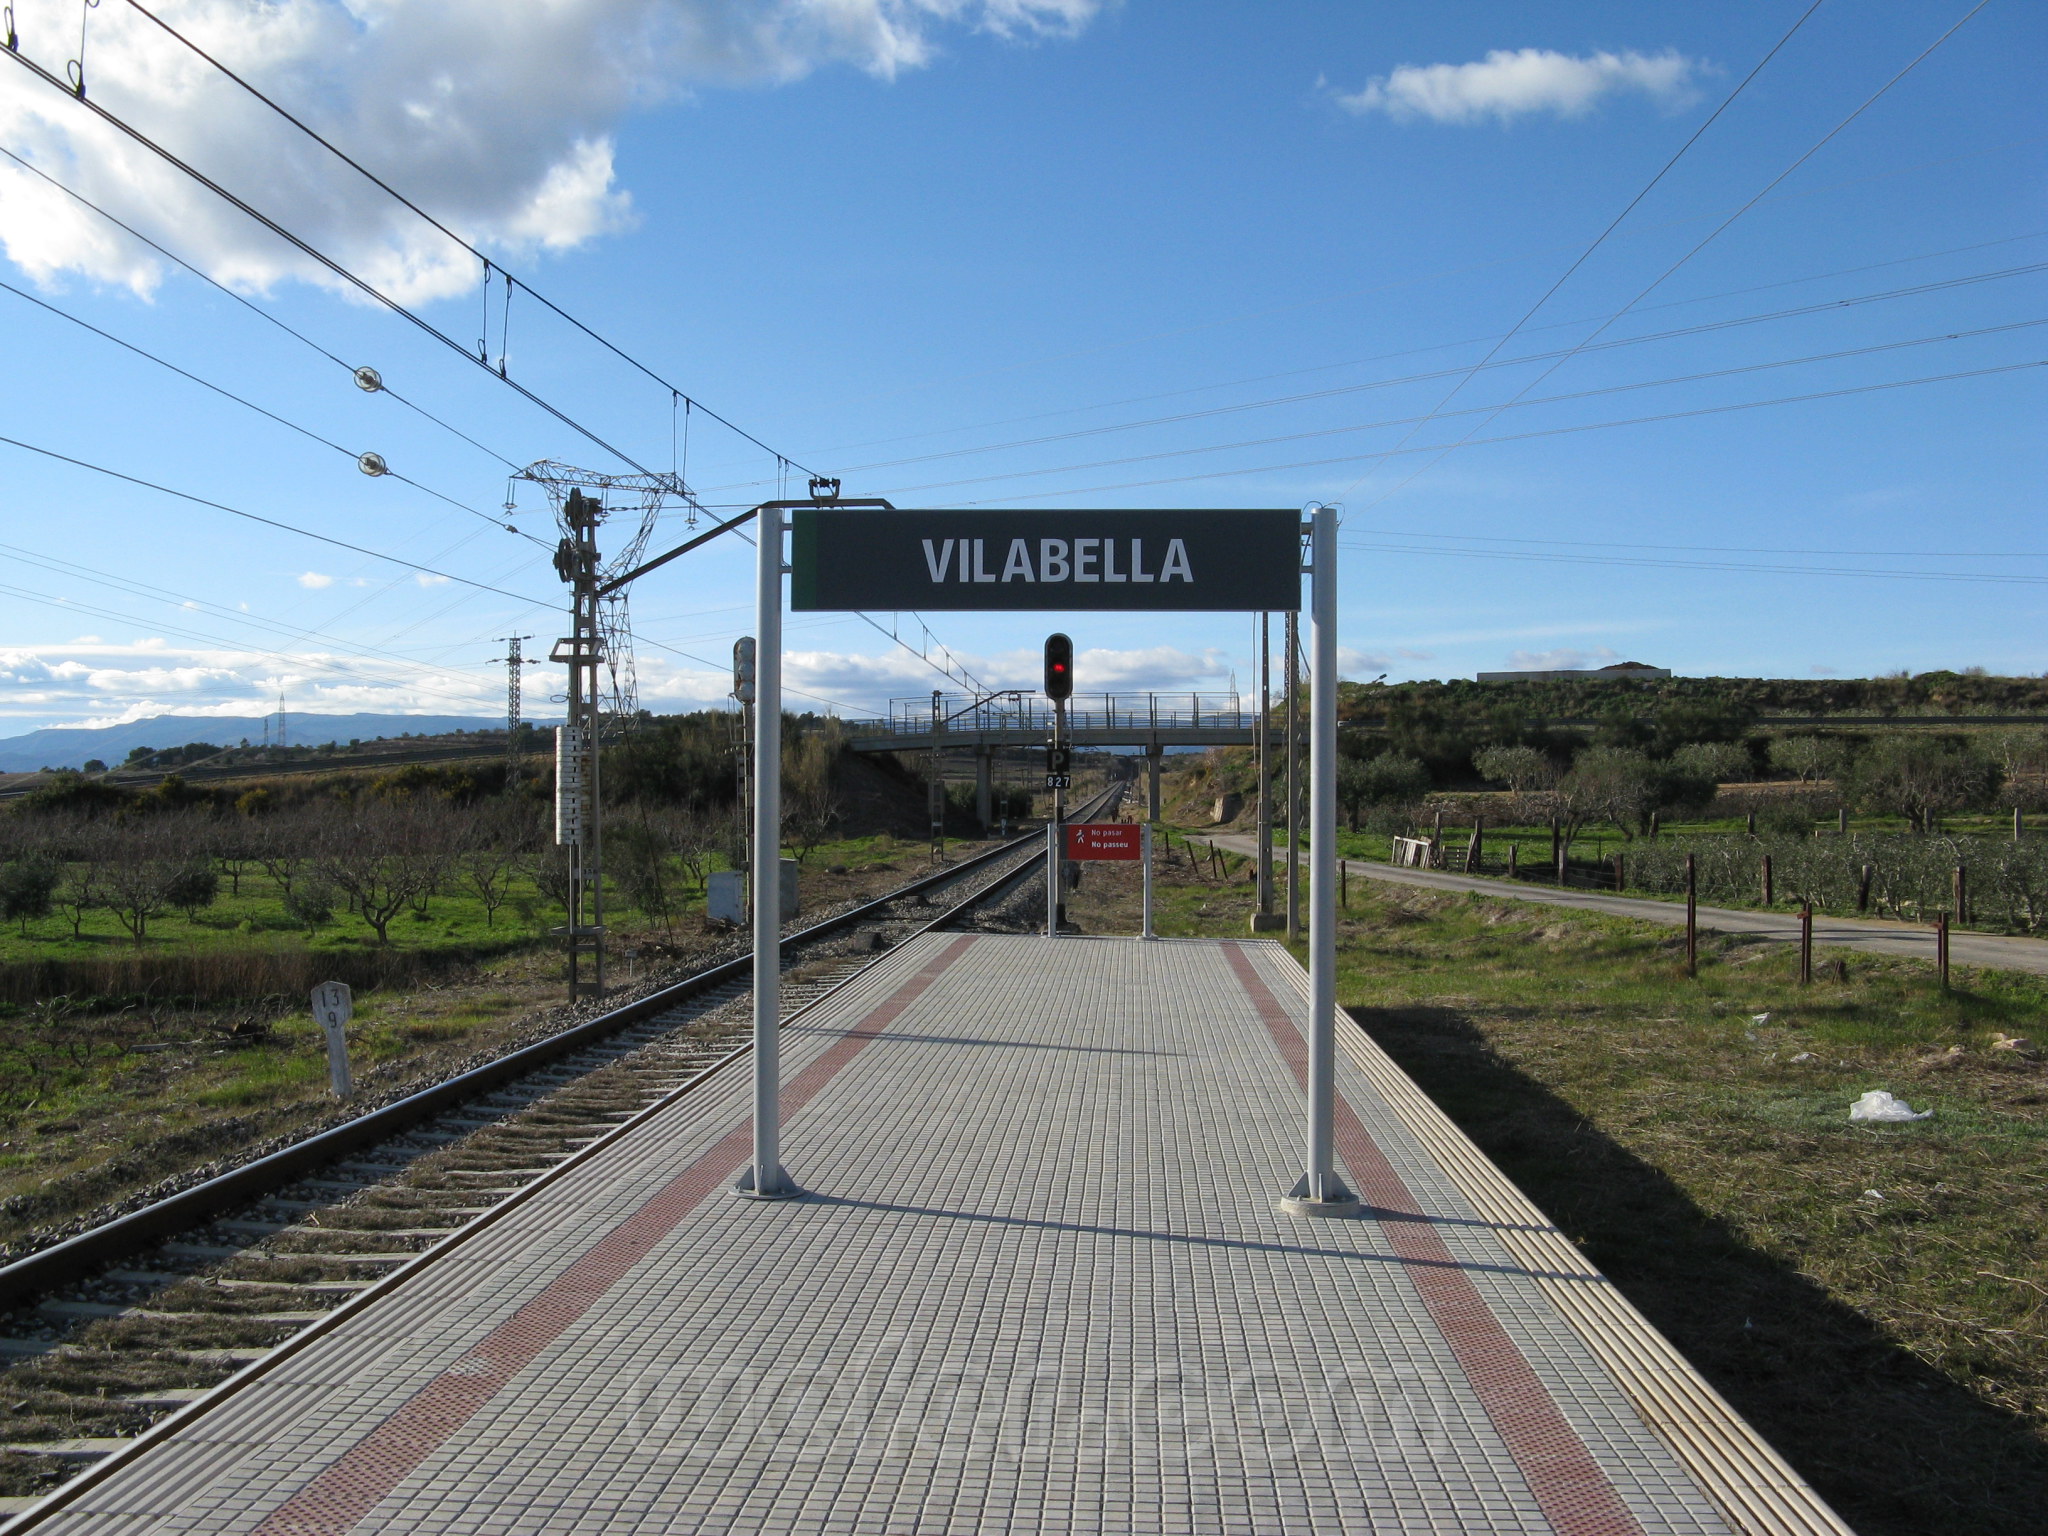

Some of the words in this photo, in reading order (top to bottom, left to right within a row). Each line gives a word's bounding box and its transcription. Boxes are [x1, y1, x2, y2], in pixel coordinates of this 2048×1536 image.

[922, 538, 1194, 583] VILABELLA
[1052, 752, 1064, 769] P
[1047, 777, 1070, 787] 827
[1103, 830, 1122, 838] pasar
[321, 988, 339, 1008] 13
[328, 1011, 337, 1028] 9
